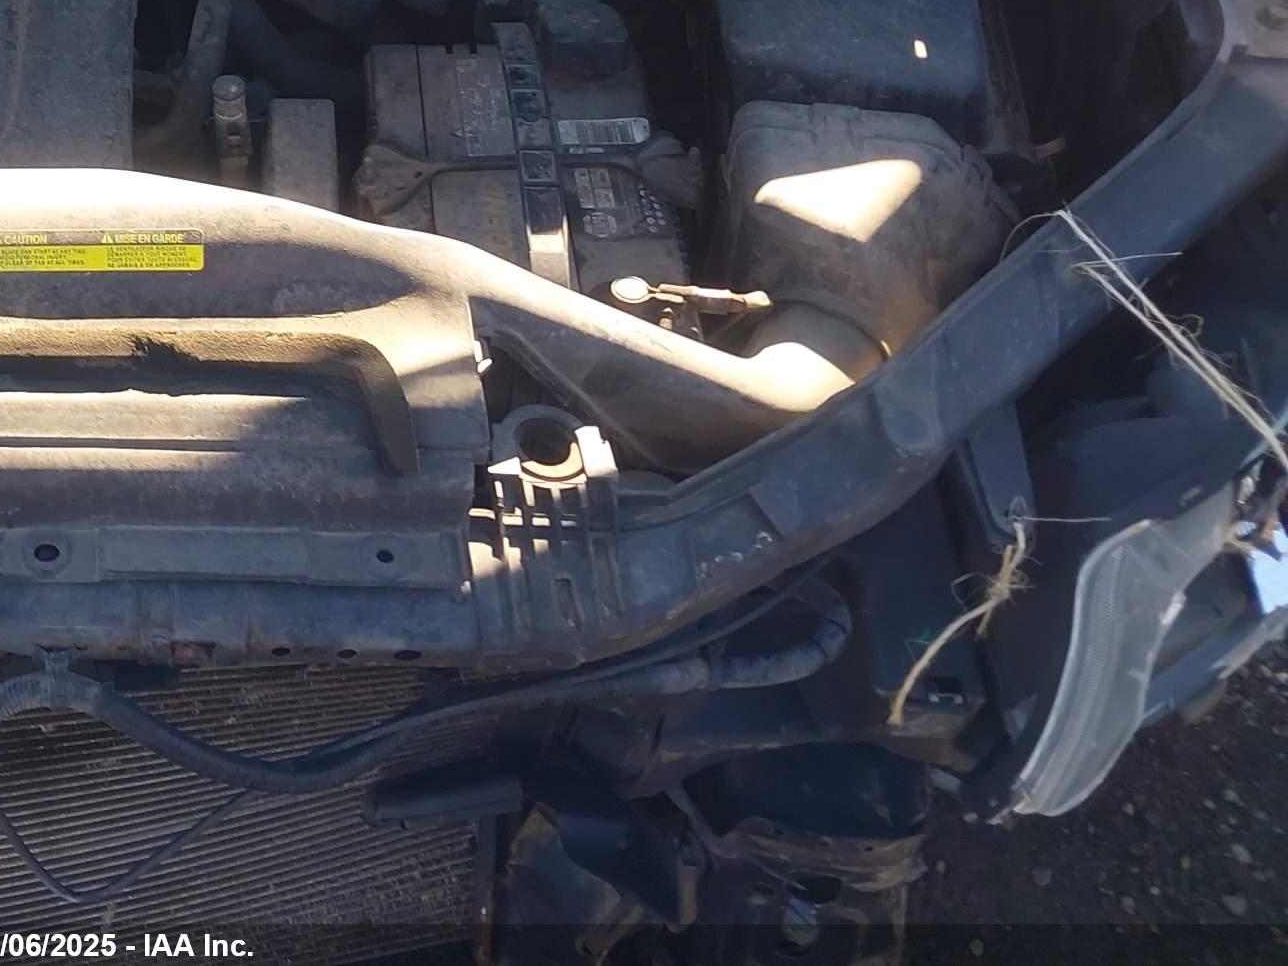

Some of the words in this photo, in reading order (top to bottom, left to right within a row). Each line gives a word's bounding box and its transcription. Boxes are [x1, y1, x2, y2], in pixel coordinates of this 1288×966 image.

[3, 234, 49, 246] CAUTION
[114, 234, 137, 244] MISE
[138, 234, 151, 244] EN
[151, 233, 185, 244] GARDE
